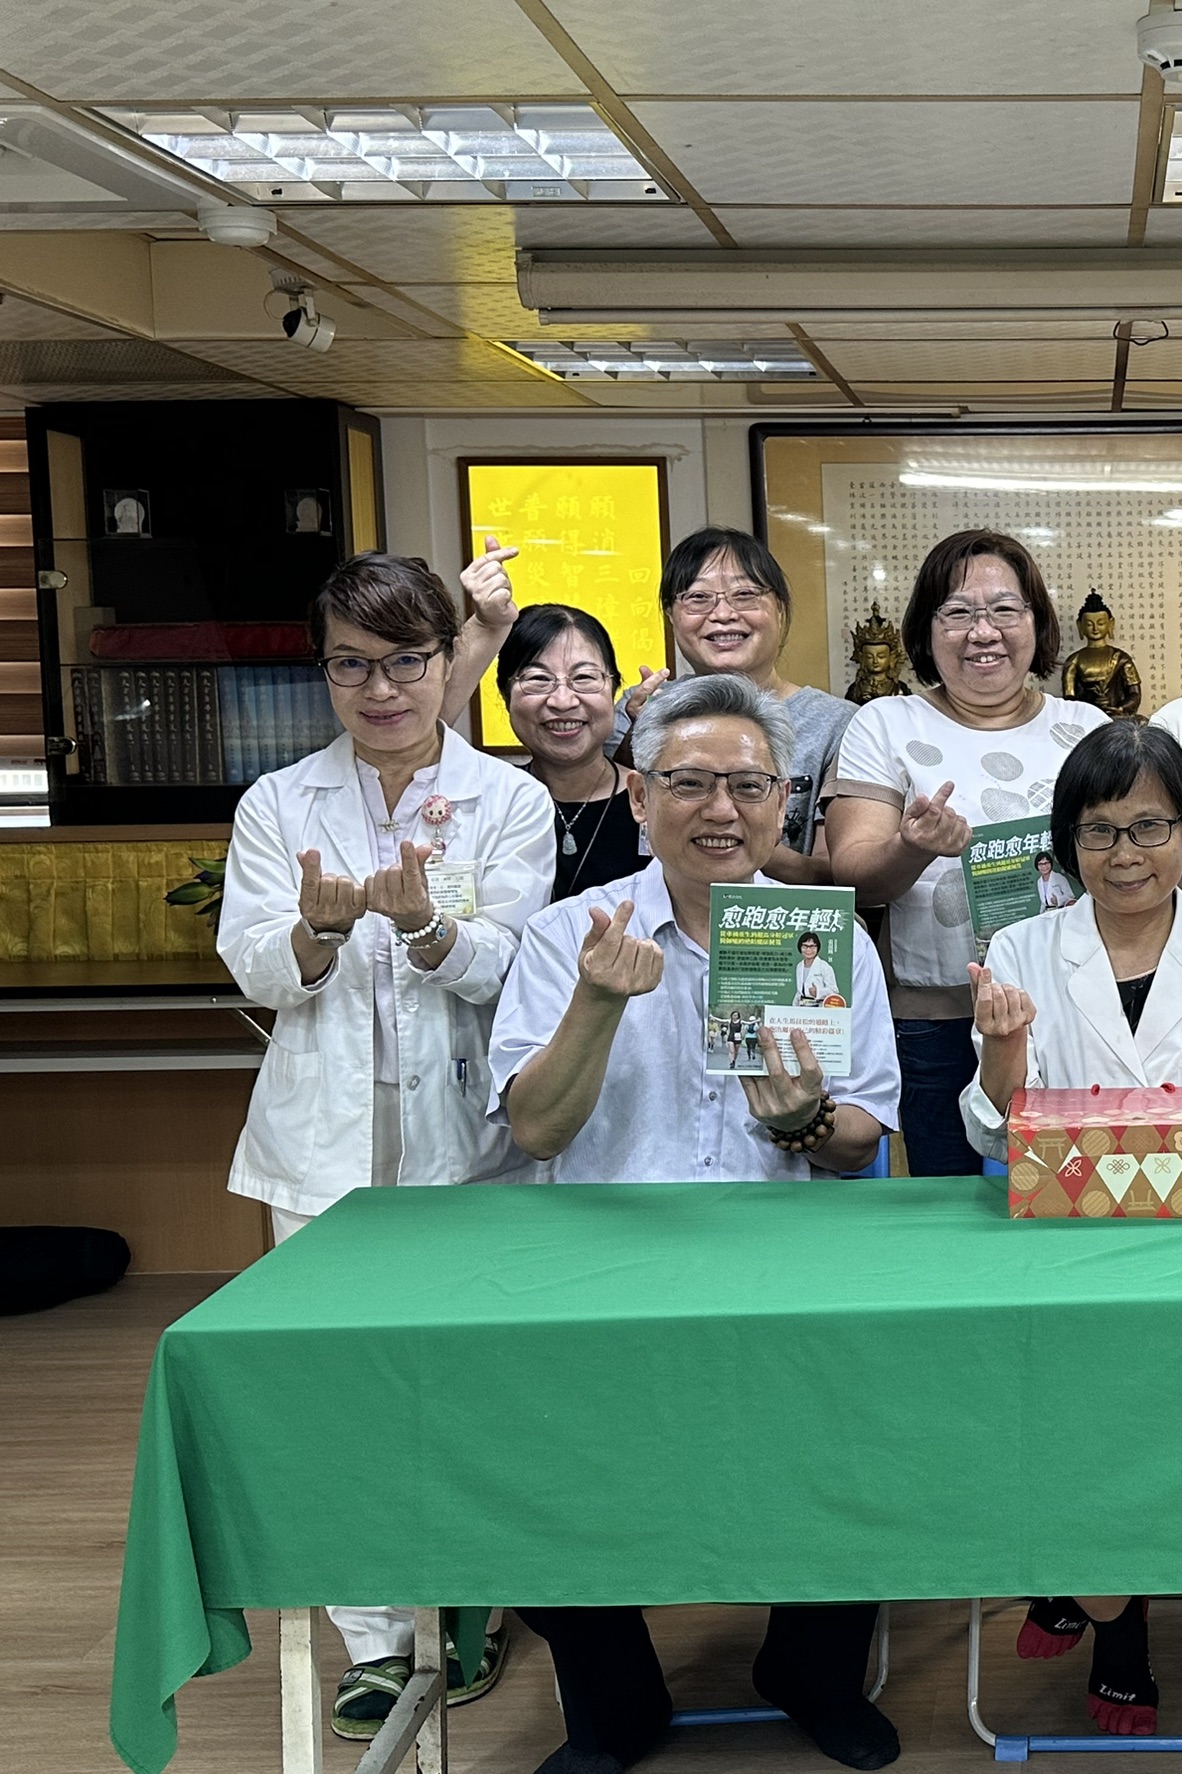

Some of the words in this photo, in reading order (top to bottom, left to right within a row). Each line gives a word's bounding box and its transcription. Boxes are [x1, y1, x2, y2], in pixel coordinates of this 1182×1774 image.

[627, 566, 654, 652] 回向偈
[718, 904, 834, 933] 愈跑愈年輕
[1099, 1683, 1136, 1702] Limit
